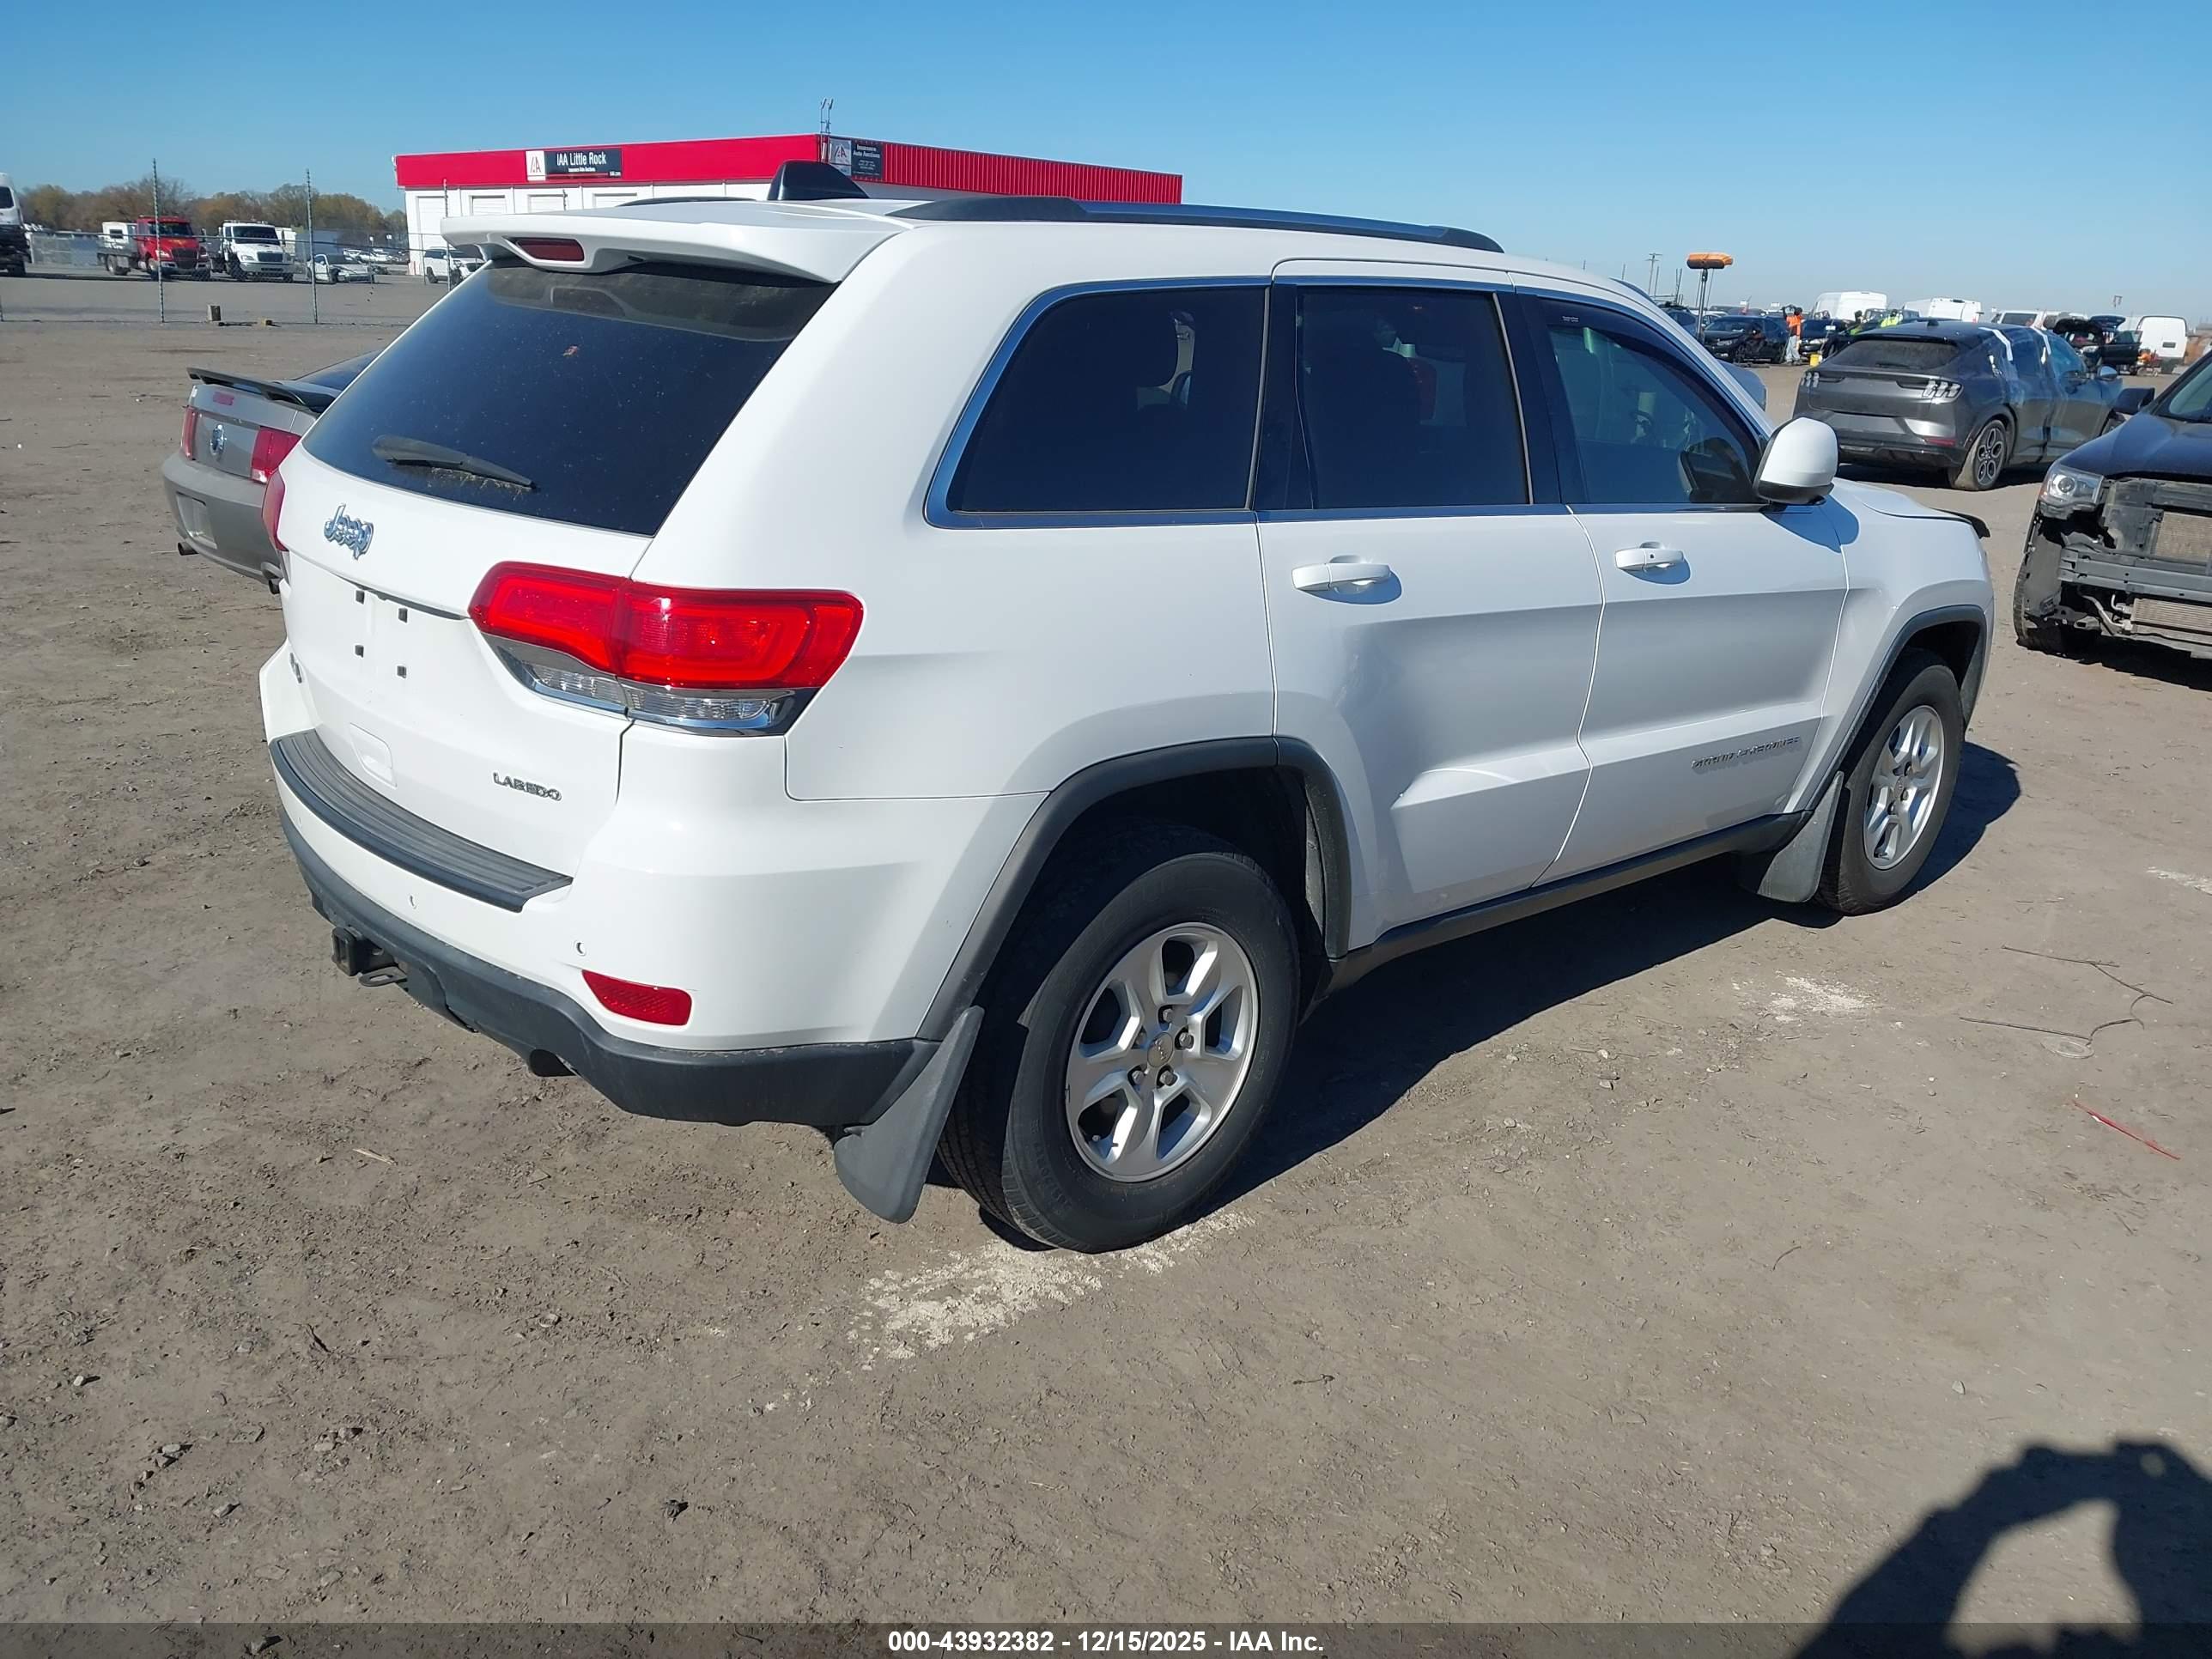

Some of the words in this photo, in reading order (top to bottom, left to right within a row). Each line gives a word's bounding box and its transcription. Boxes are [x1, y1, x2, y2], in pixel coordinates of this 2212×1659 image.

[556, 153, 568, 166] IAA
[569, 152, 587, 166] Little
[588, 151, 607, 165] Rock
